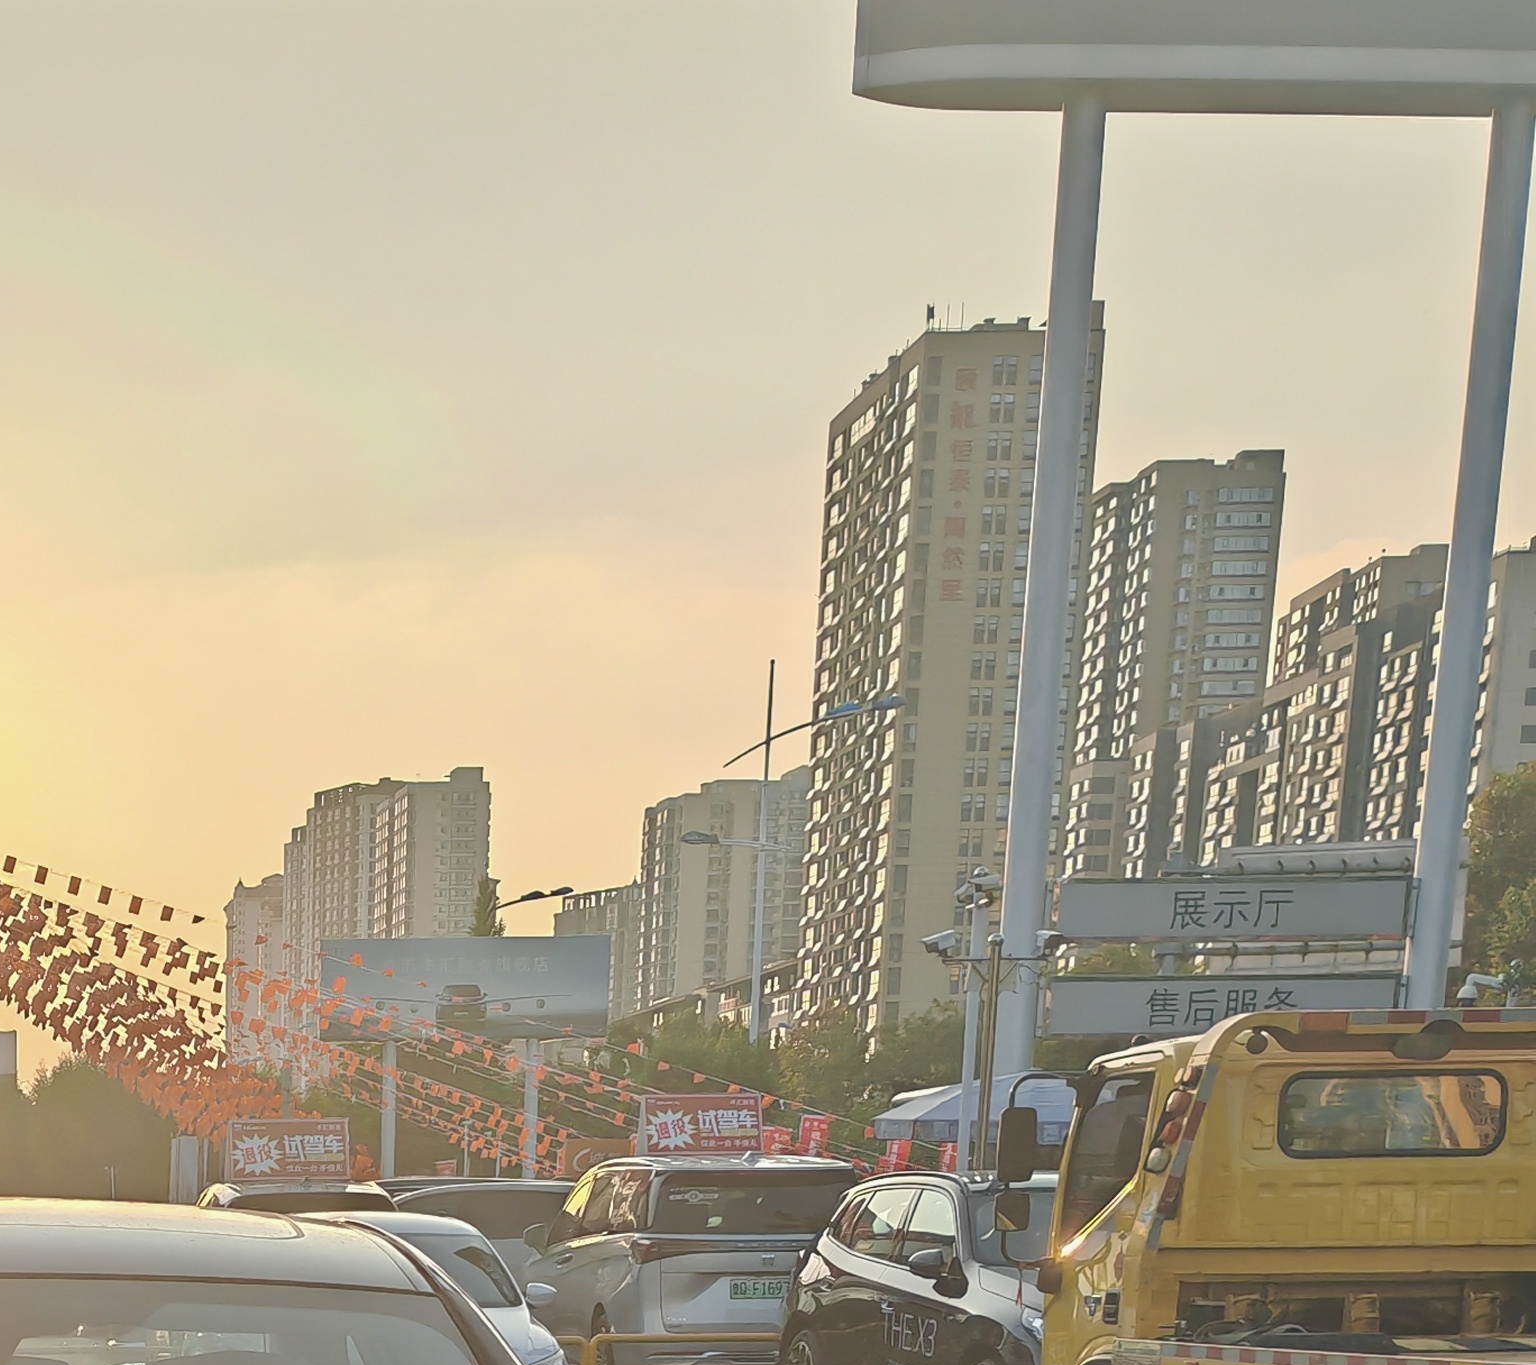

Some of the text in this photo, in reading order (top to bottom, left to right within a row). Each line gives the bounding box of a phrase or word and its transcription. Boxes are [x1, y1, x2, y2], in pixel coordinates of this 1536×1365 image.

[1169, 889, 1295, 929] 展示厅
[1145, 986, 1298, 1027] 售后服务
[697, 1108, 758, 1137] 试驾车
[283, 1134, 345, 1162] 试驾车
[881, 1309, 938, 1357] THE X3
